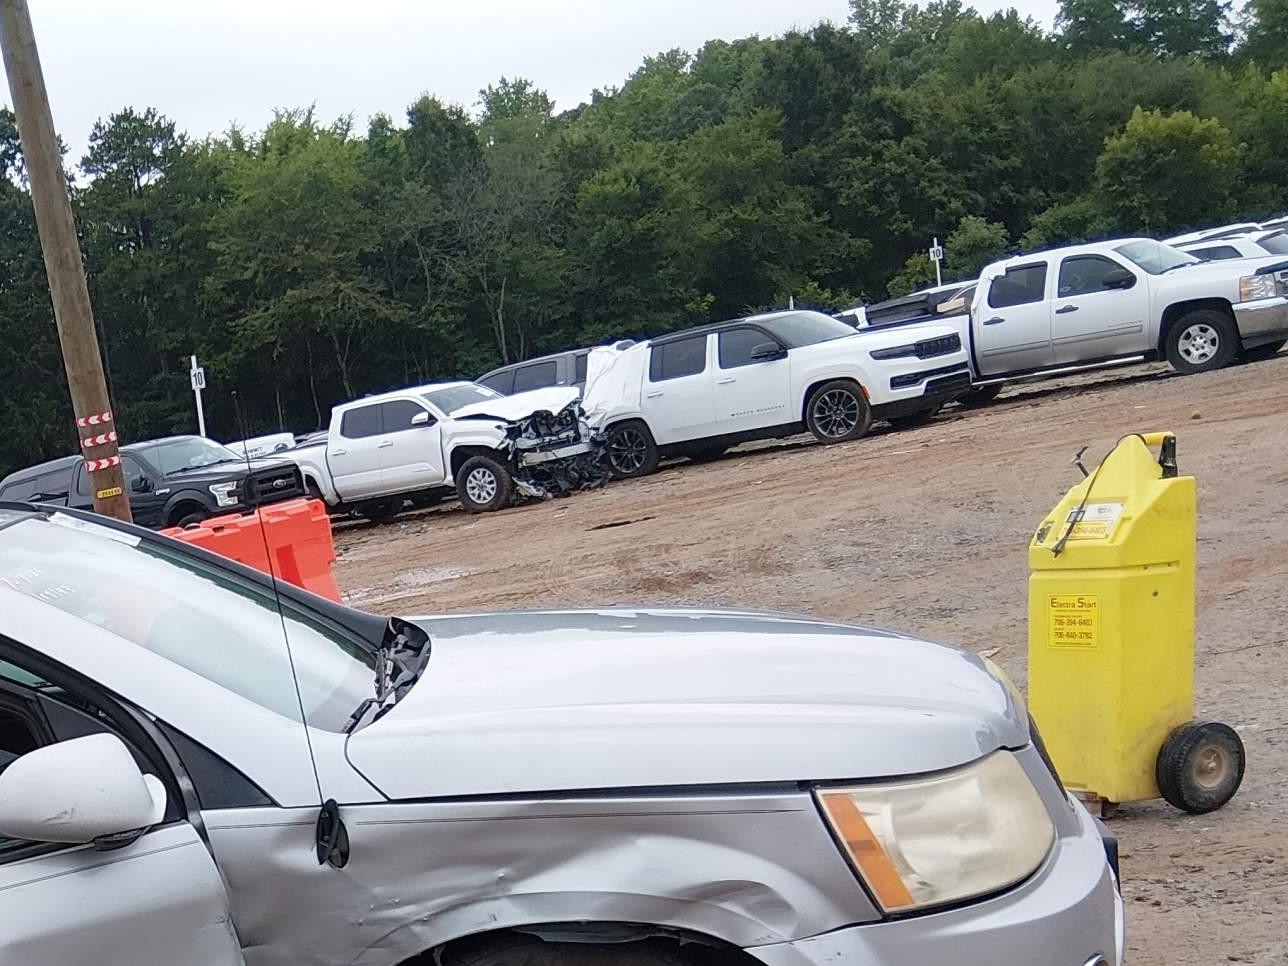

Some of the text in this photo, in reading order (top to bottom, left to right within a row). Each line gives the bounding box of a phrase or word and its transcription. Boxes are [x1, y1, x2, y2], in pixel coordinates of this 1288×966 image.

[932, 248, 942, 258] 10
[192, 371, 204, 386] 10
[1051, 597, 1097, 608] Electra Start
